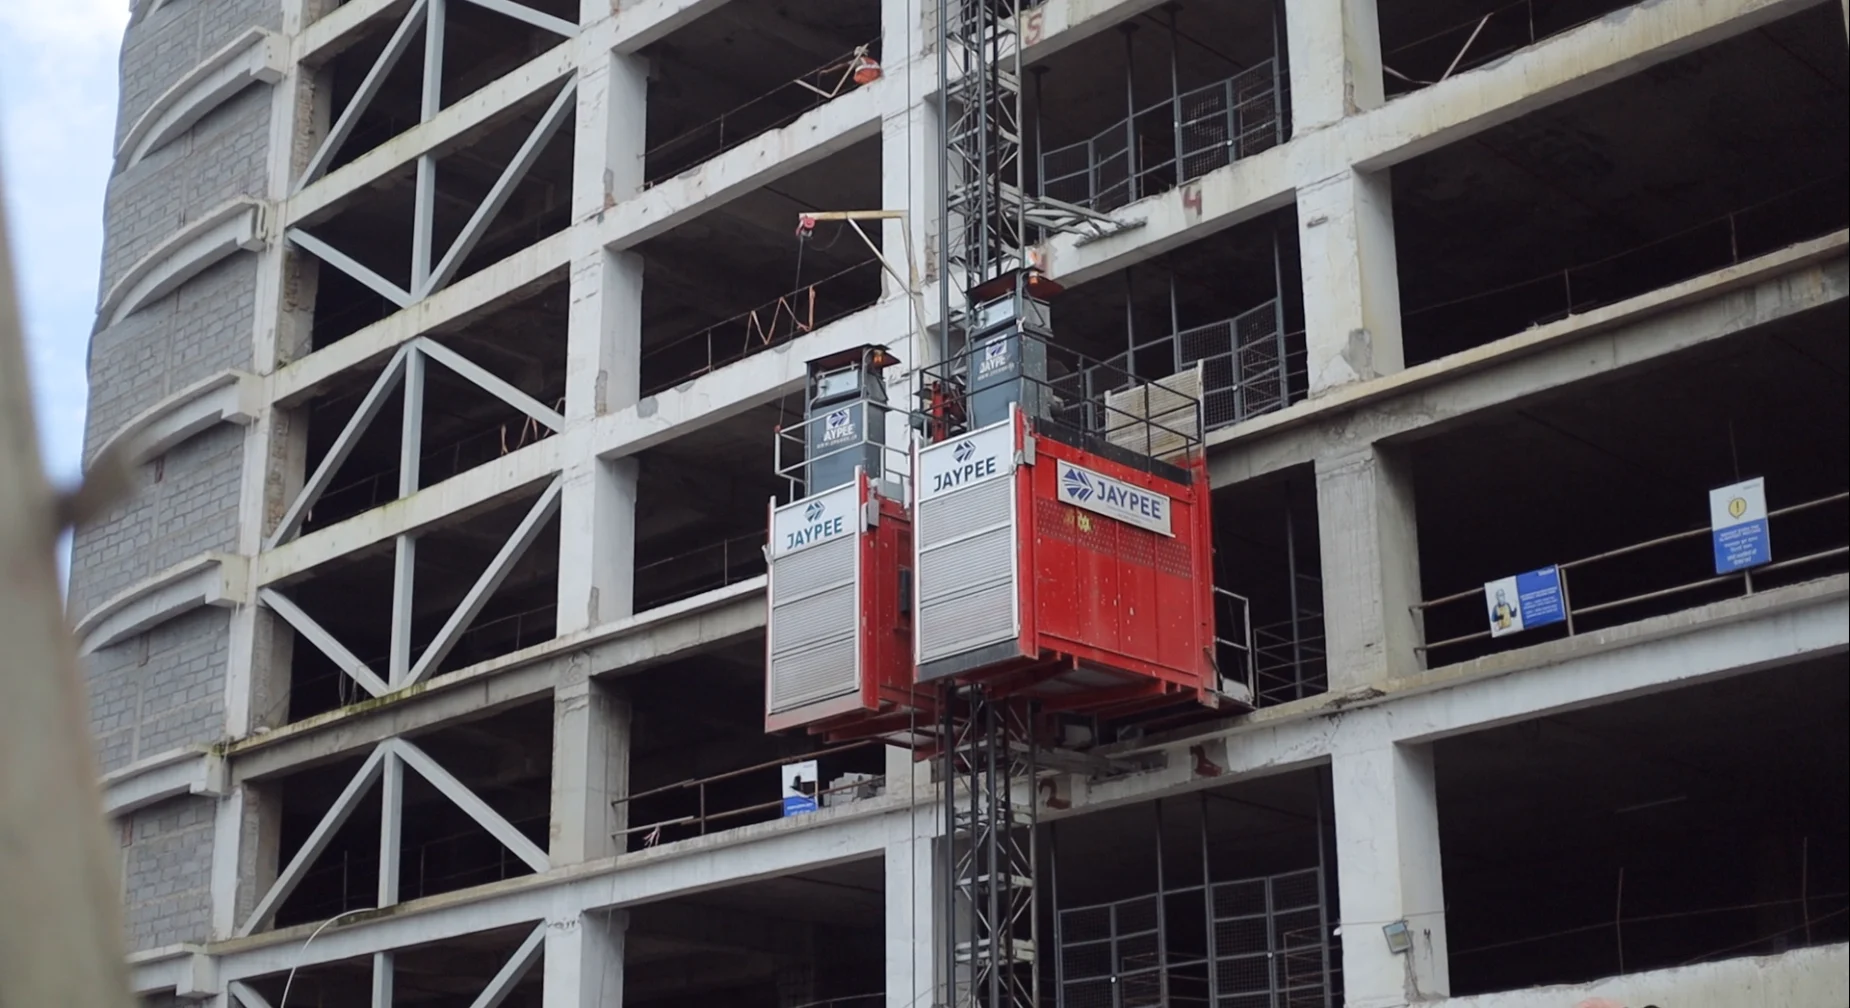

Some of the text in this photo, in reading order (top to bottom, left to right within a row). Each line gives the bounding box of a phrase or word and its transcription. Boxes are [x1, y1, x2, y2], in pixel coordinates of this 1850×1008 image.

[1024, 12, 1043, 44] 5
[1182, 188, 1202, 216] 4
[933, 456, 996, 492] JAYPEE
[1097, 481, 1162, 520] JAYPEE
[787, 516, 843, 550] JAYPEE
